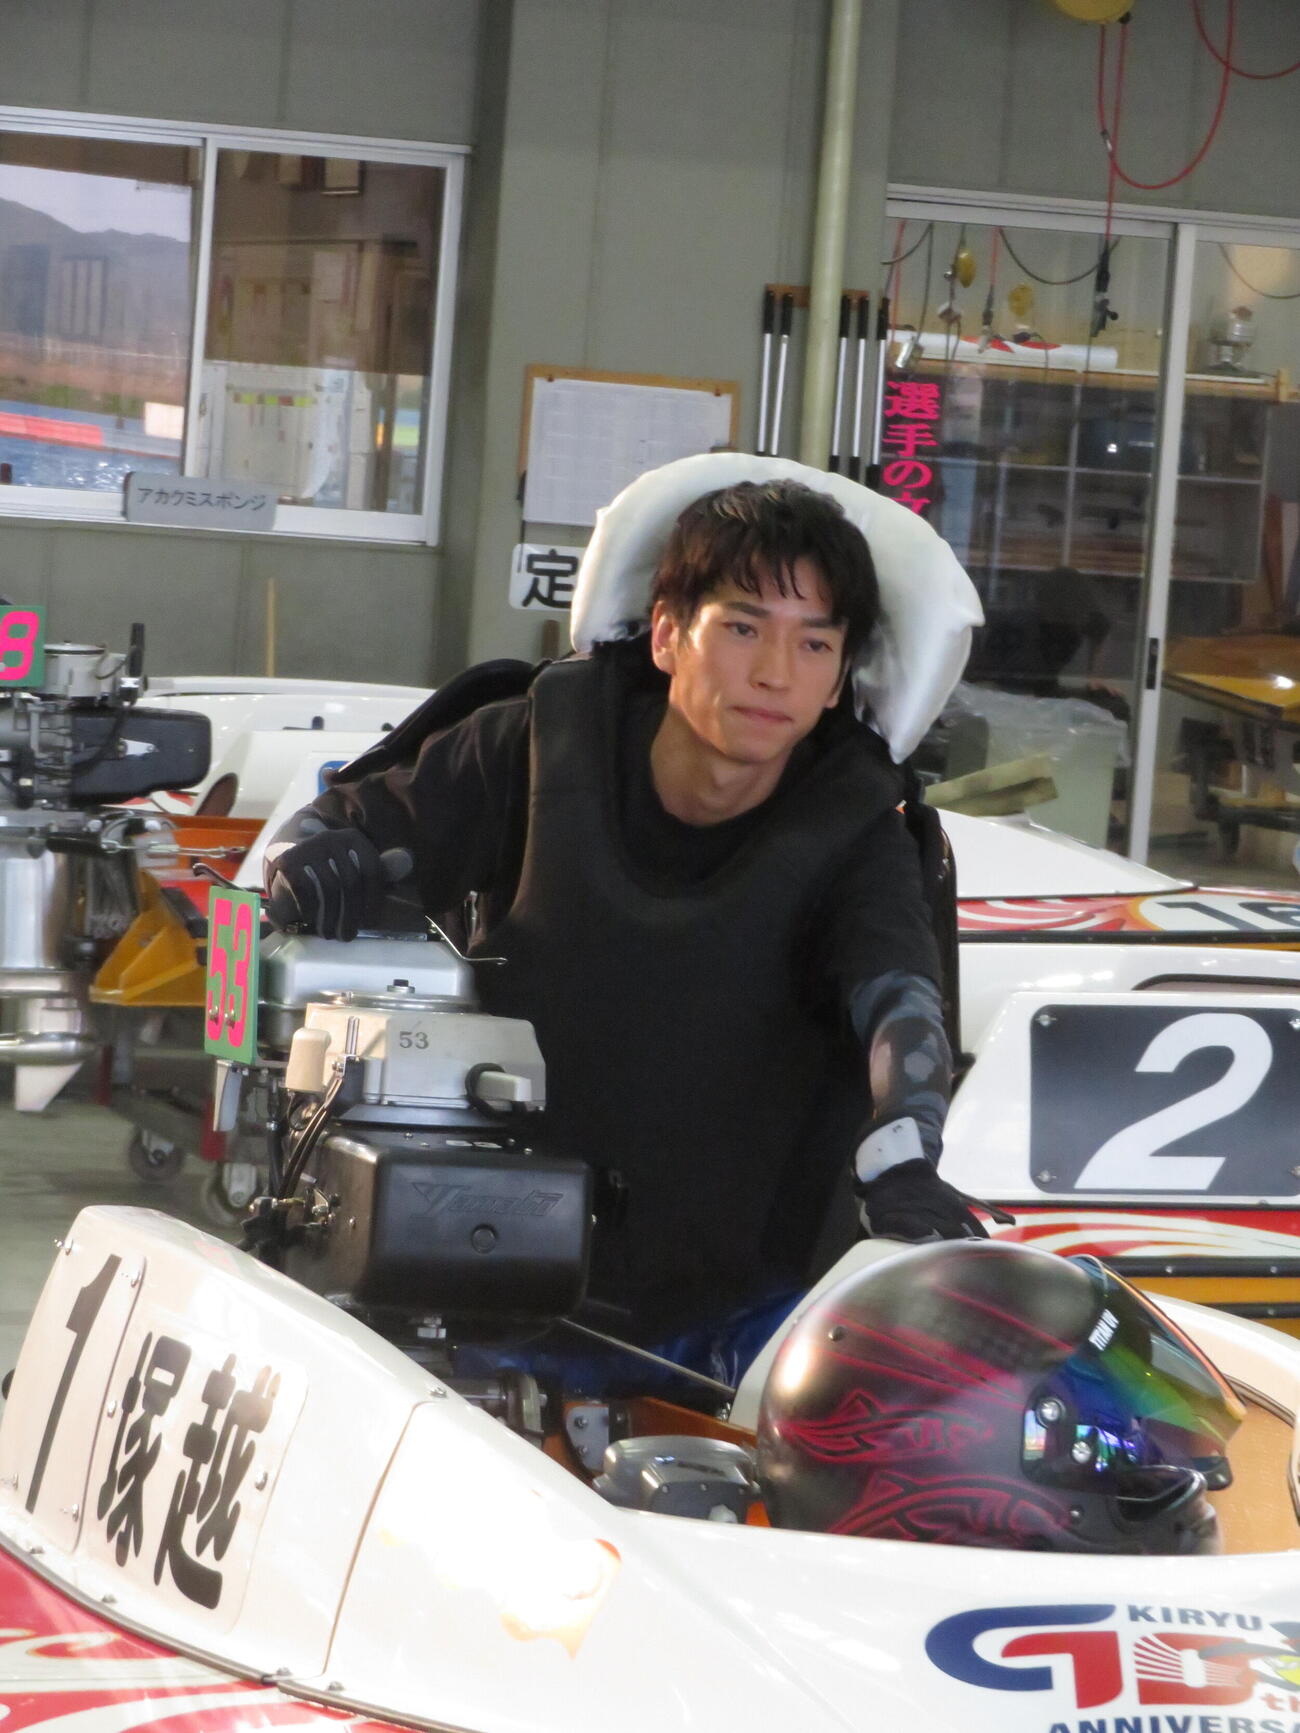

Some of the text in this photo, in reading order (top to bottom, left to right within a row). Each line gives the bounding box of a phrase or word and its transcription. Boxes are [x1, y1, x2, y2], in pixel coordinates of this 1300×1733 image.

[522, 549, 579, 608] 定
[207, 898, 253, 1048] 53
[399, 1031, 430, 1050] 53
[1074, 1012, 1273, 1190] 2
[25, 1253, 123, 1514] 1
[1127, 1604, 1263, 1632] KIRYU
